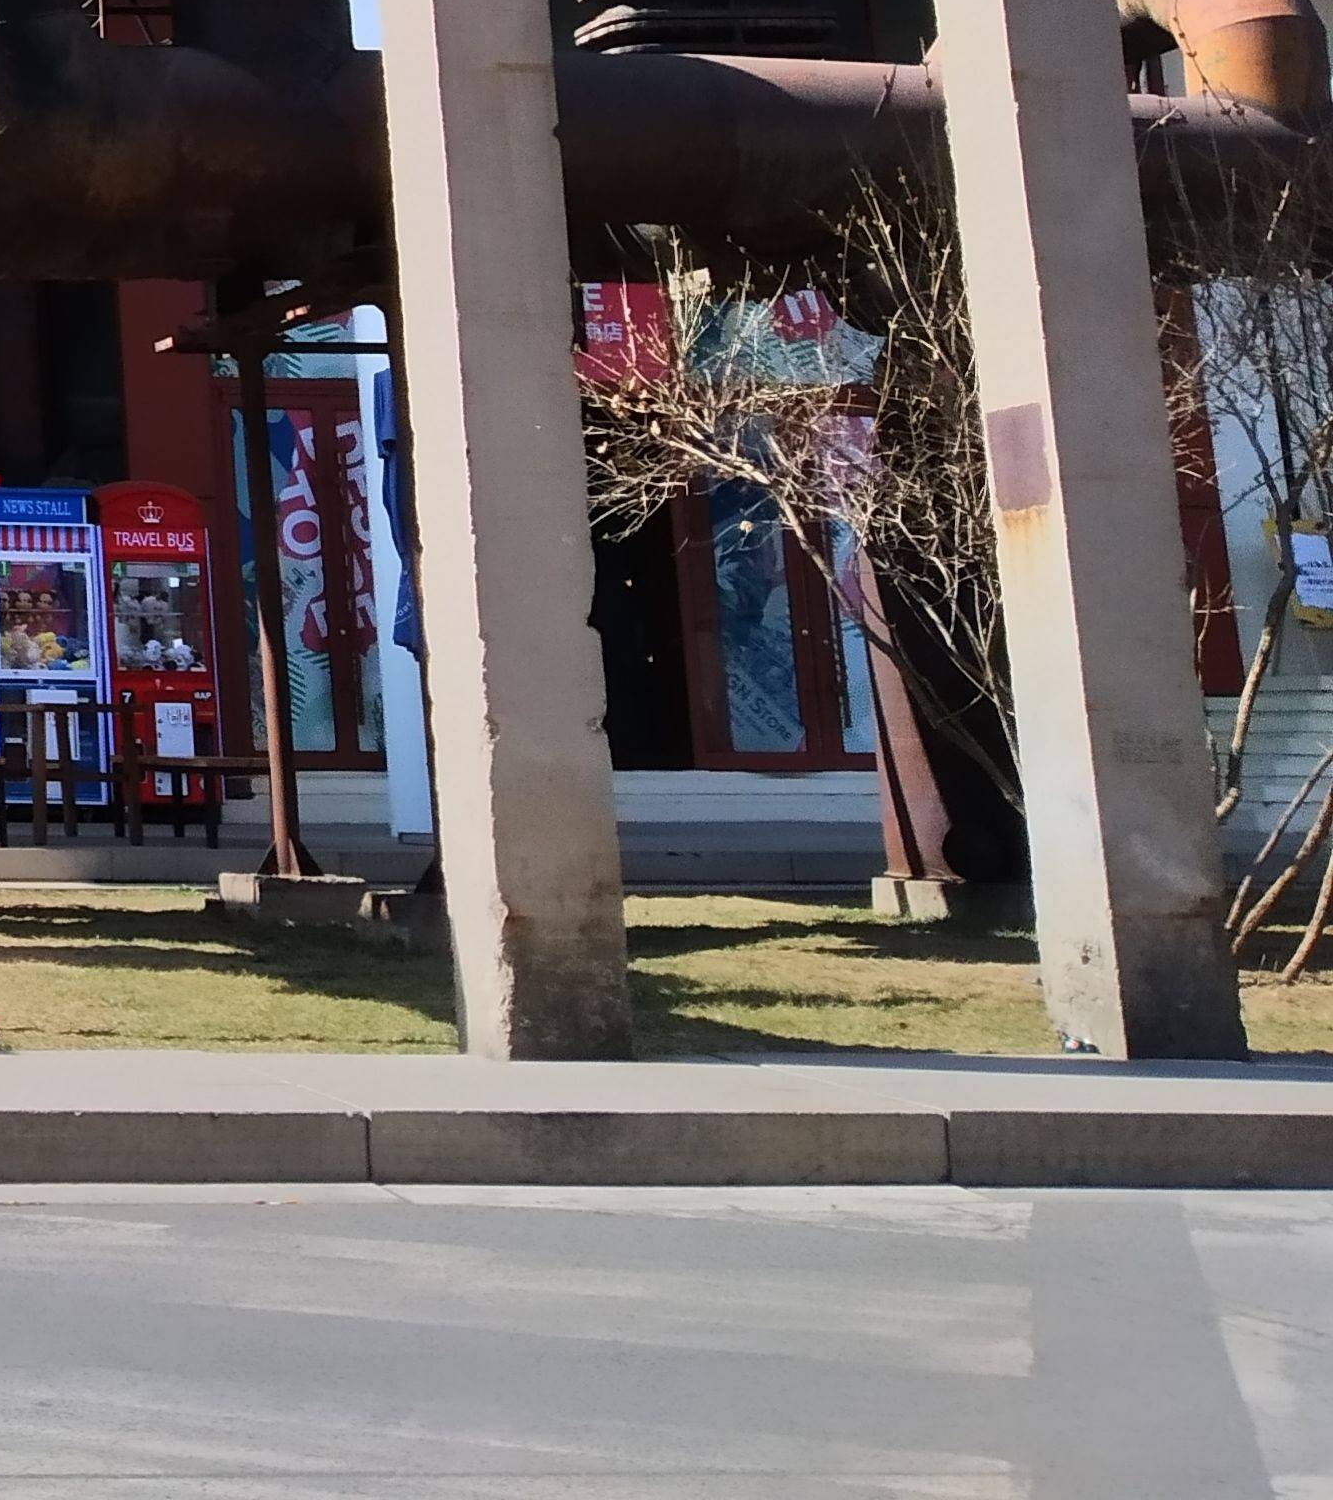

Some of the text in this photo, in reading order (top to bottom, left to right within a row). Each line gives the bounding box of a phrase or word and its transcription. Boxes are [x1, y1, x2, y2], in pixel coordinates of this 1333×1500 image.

[2, 499, 72, 516] NEWS STALL
[113, 531, 195, 548] TRAVEL BUS
